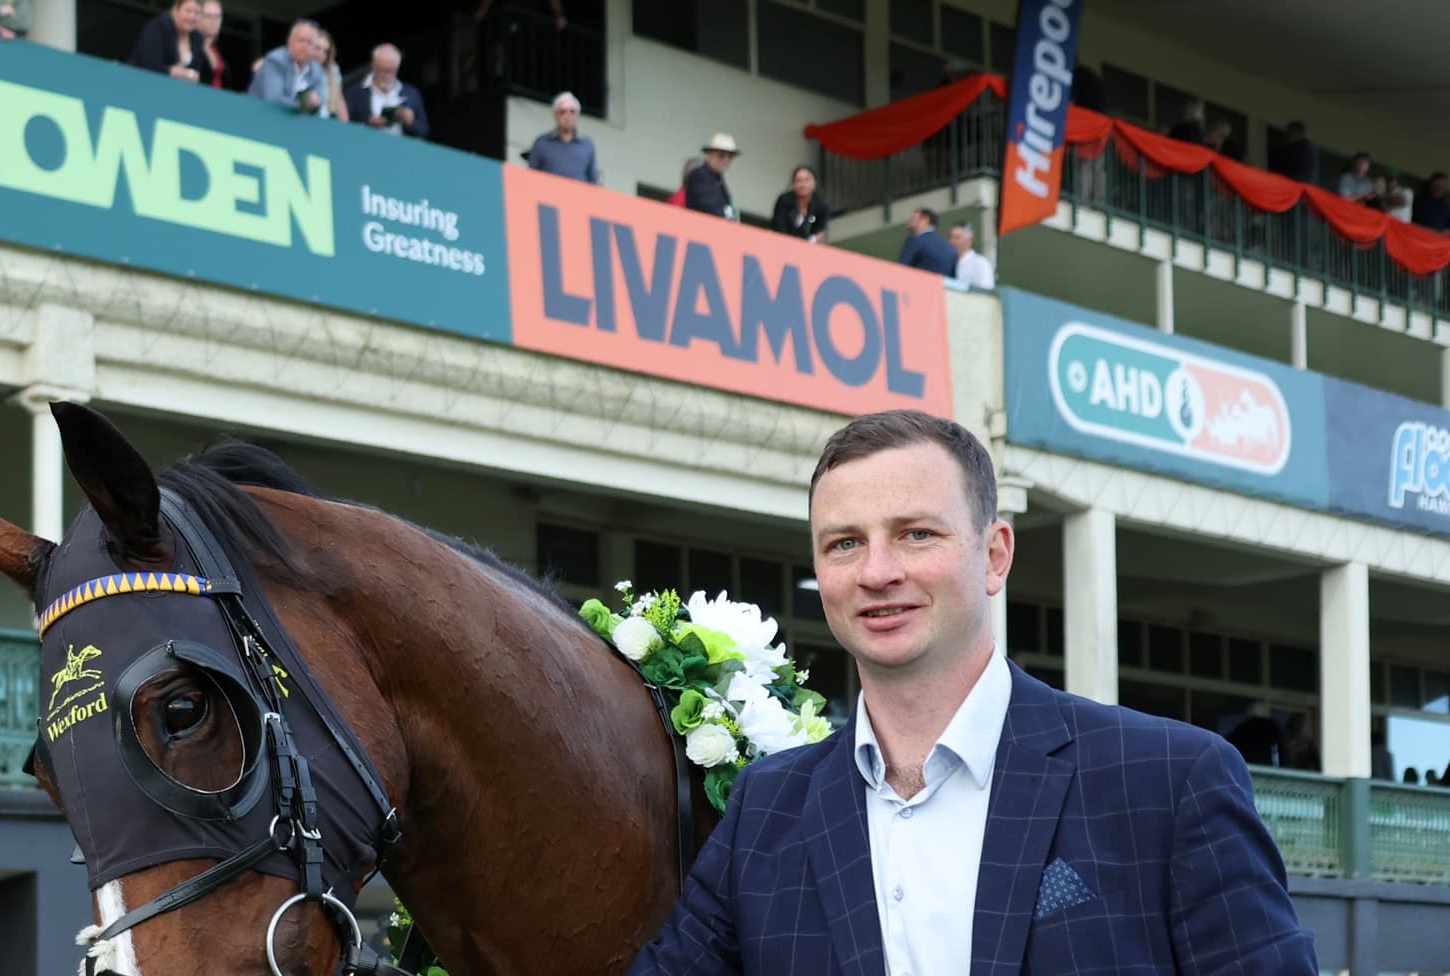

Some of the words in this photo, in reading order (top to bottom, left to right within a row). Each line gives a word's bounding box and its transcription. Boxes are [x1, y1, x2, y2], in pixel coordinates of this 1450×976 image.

[1014, 0, 1074, 199] Hirepo
[361, 184, 460, 241] Insuring
[362, 221, 486, 277] Greatness
[537, 202, 927, 399] LIVAMOL
[1089, 357, 1163, 419] AHD
[47, 692, 110, 742] Wexford
